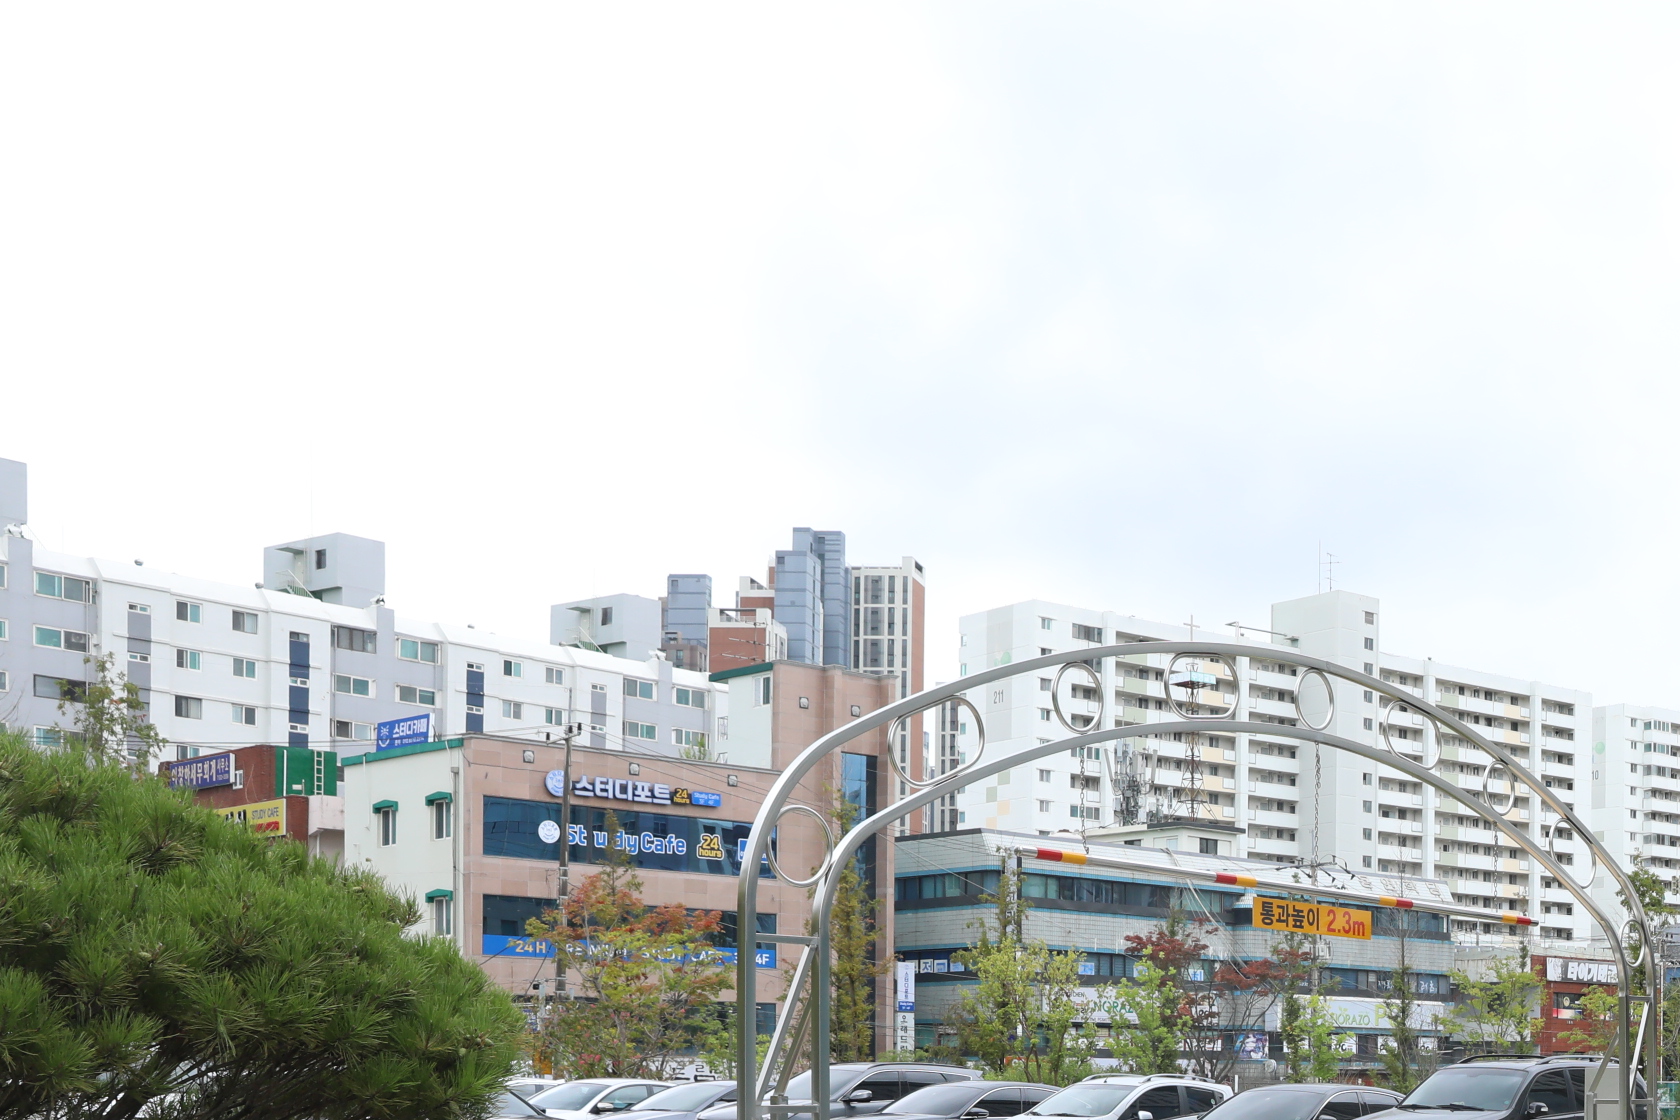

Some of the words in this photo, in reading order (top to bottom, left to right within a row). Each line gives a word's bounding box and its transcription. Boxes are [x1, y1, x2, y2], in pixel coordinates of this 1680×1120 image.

[992, 690, 1004, 705] 211
[392, 717, 428, 738] 스터디카페
[573, 775, 672, 805] 스터디포트
[676, 788, 688, 798] 24
[640, 832, 687, 855] Cafe
[701, 835, 720, 850] 24
[698, 847, 723, 860] hours
[1260, 901, 1320, 931] 통과높이
[1326, 909, 1366, 937] 2.3m
